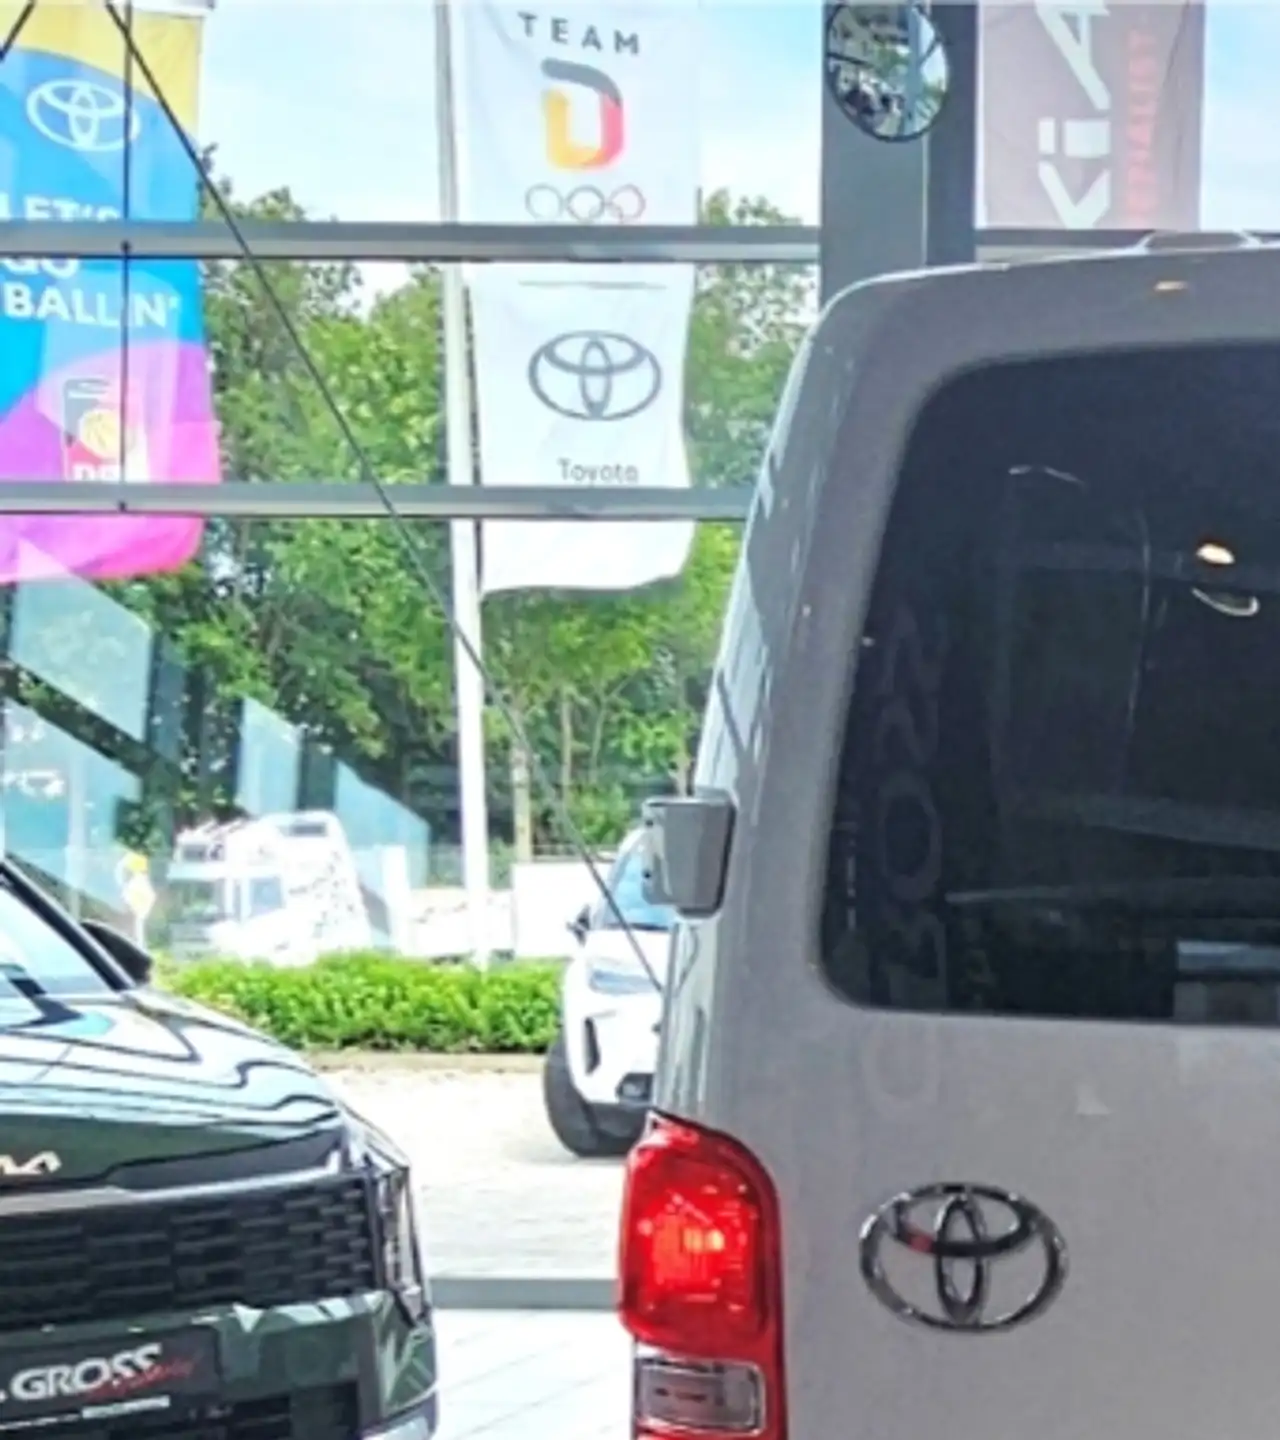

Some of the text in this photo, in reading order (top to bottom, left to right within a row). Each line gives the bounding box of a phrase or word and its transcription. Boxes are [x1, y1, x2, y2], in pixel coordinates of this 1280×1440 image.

[517, 11, 640, 56] TEAM
[3, 281, 181, 328] BALLN'
[558, 456, 639, 487] Toyota
[10, 1342, 162, 1400] GROSS
